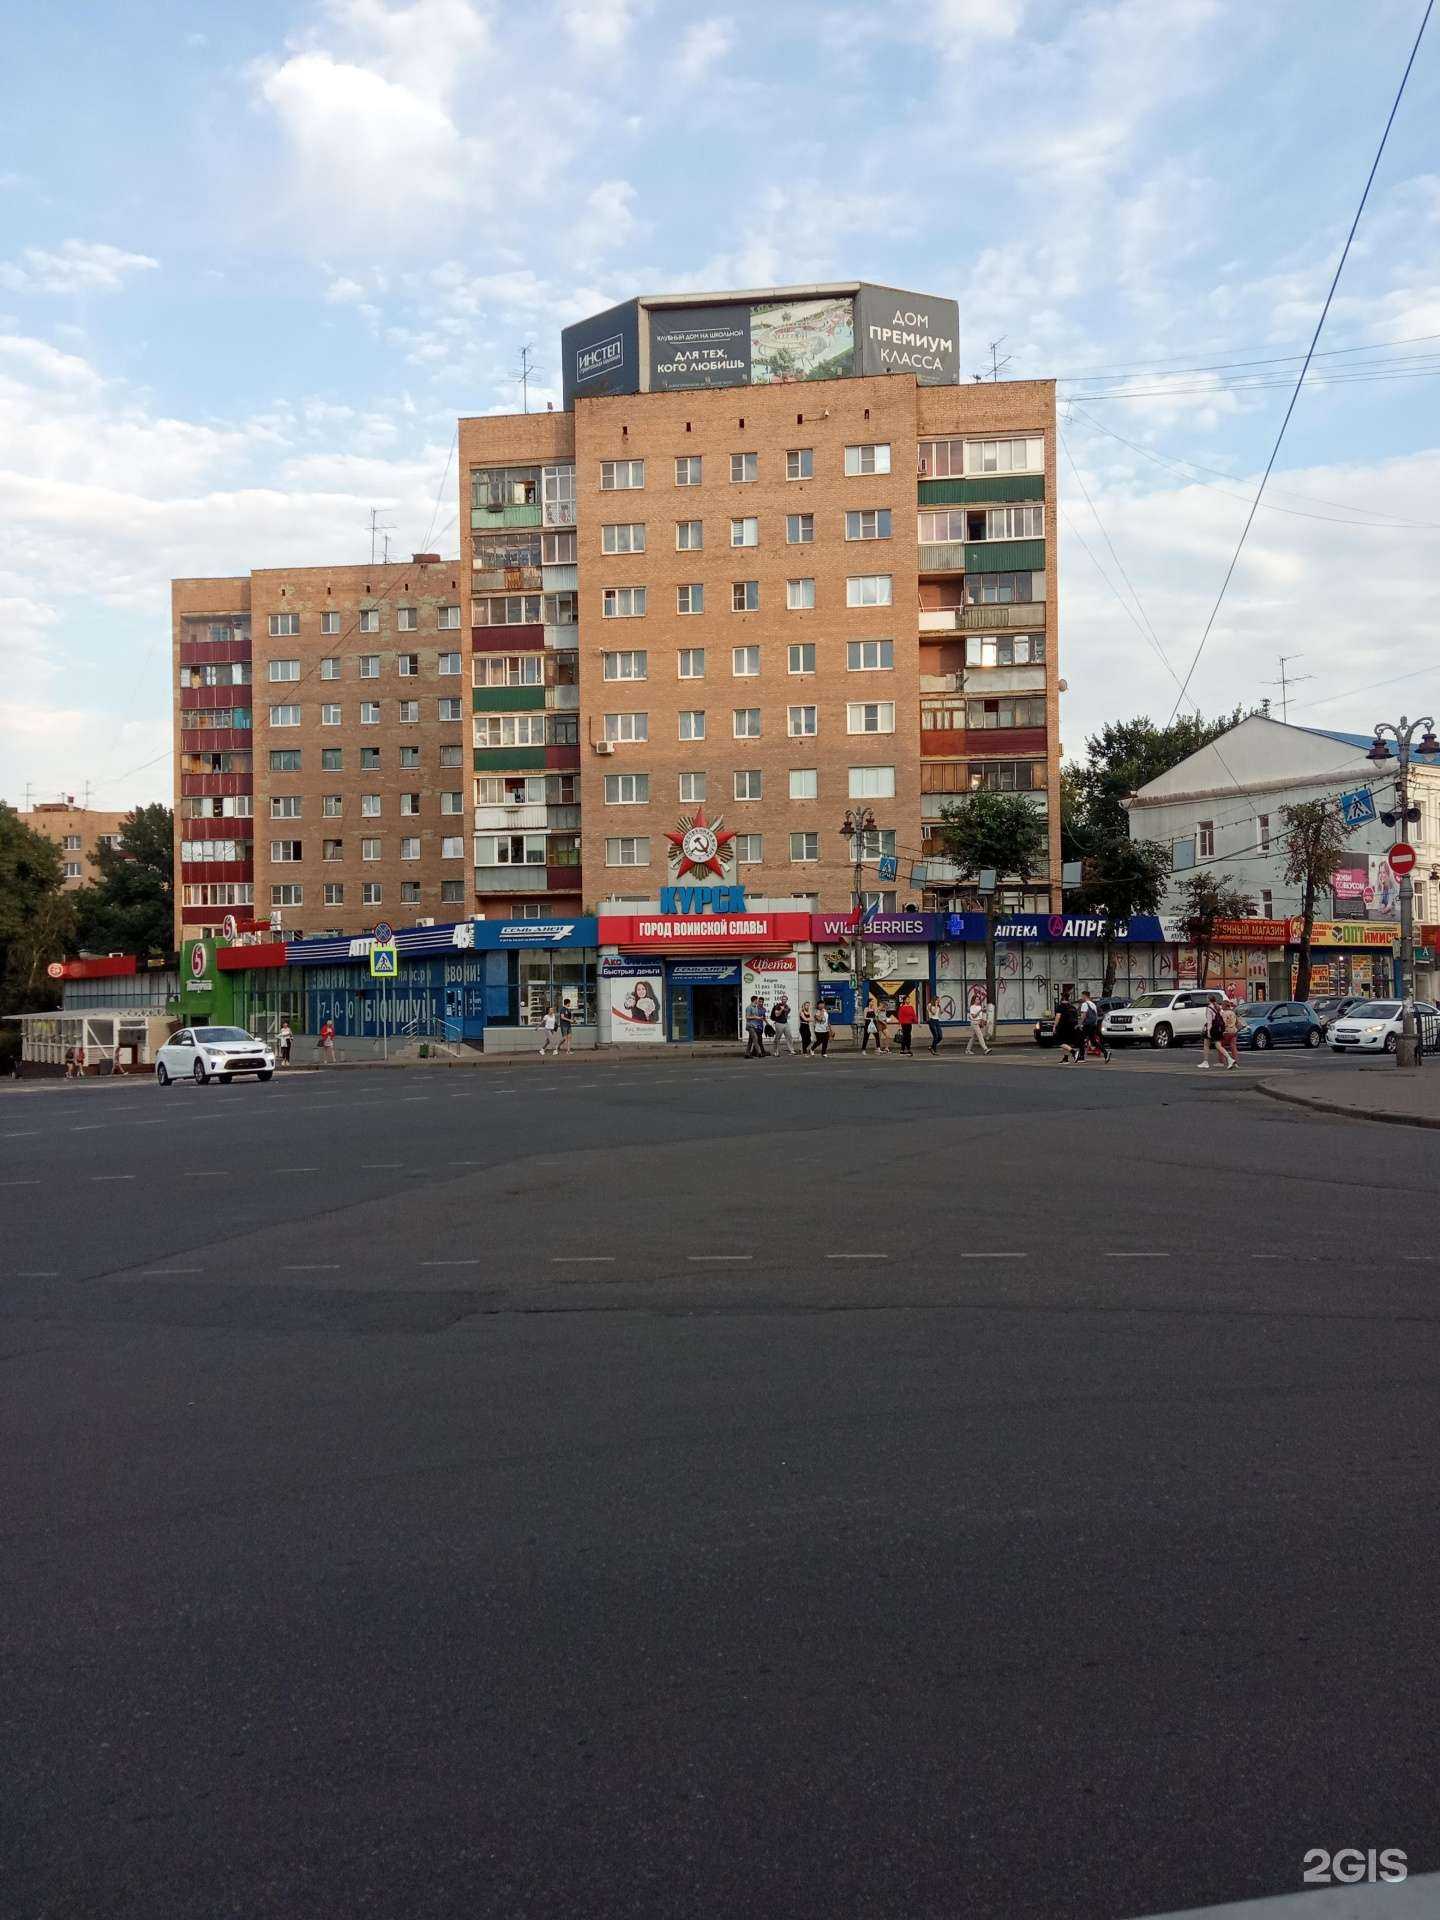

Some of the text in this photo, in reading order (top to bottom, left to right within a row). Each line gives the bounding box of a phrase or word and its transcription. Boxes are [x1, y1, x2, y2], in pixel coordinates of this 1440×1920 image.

[892, 310, 929, 328] ДОМ
[869, 324, 953, 353] ПРЕМИУМ
[579, 341, 621, 369] ИНСТЕП
[674, 348, 728, 362] ДЛЯ ТЕХ,
[880, 348, 943, 371] КЛАССА
[657, 360, 745, 373] КОГО ЛЮБИШЬ
[659, 885, 747, 914] КУРСК
[639, 919, 767, 938] ГОРОД ВОИНСКОЙ СЛАВЫ
[994, 925, 1038, 937] АПТЕКА
[1251, 925, 1285, 936] МАГАЗИН
[603, 968, 660, 976] Быстрые деньги
